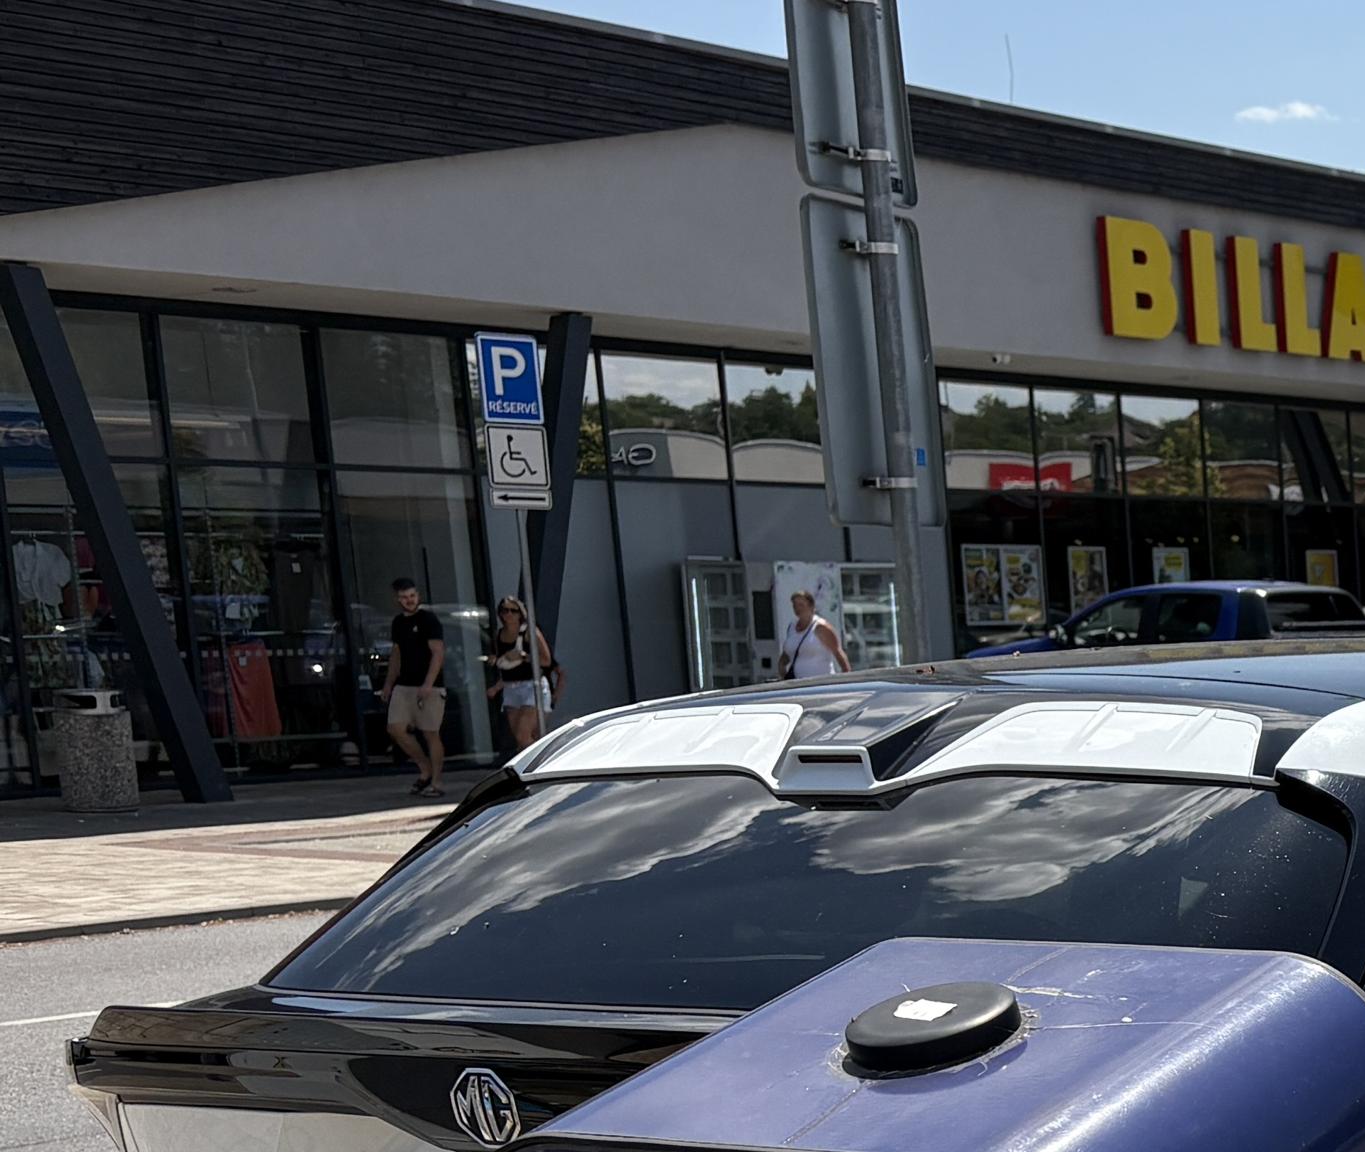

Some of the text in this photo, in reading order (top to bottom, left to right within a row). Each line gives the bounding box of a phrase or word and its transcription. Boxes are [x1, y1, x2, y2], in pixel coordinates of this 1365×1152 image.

[491, 346, 526, 396] P
[488, 400, 539, 415] RÉSERVÉ
[456, 1075, 514, 1142] MG
